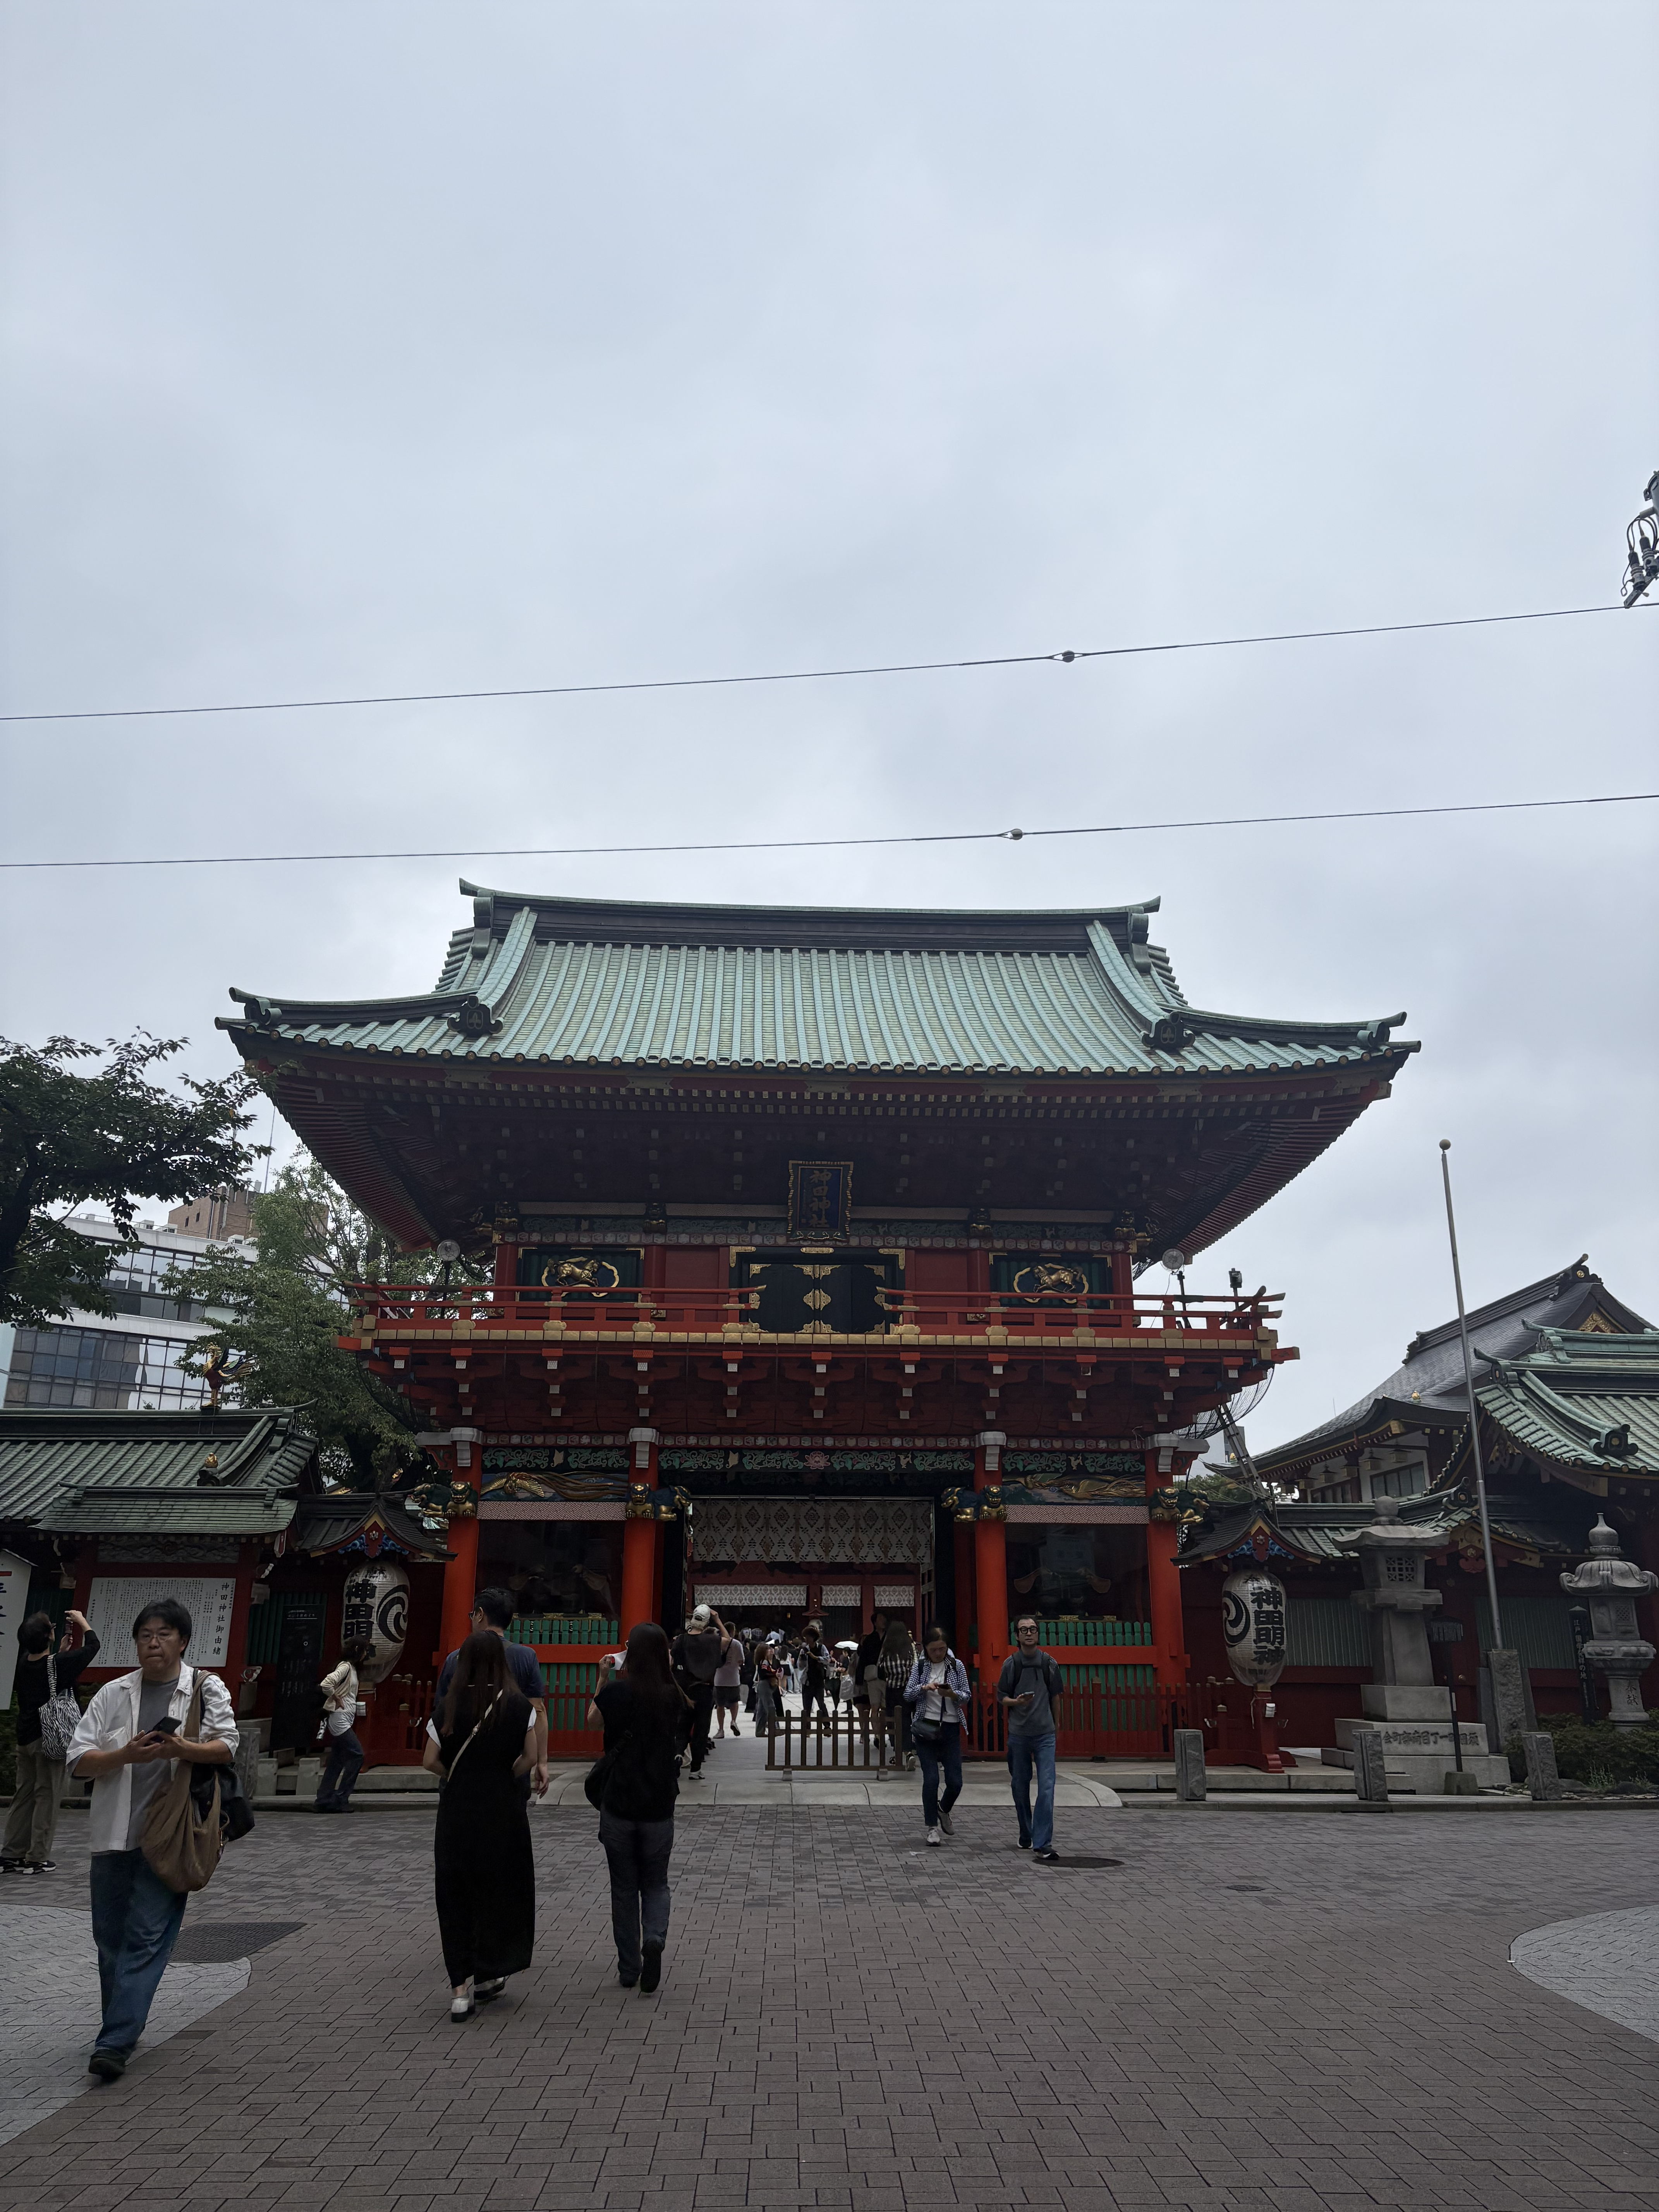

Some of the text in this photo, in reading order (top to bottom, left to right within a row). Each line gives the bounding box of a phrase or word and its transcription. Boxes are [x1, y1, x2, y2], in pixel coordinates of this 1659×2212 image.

[808, 1170, 832, 1228] 神田神社
[213, 1582, 230, 1655] 神田神社御由緒
[1250, 1586, 1285, 1666] 神田明神
